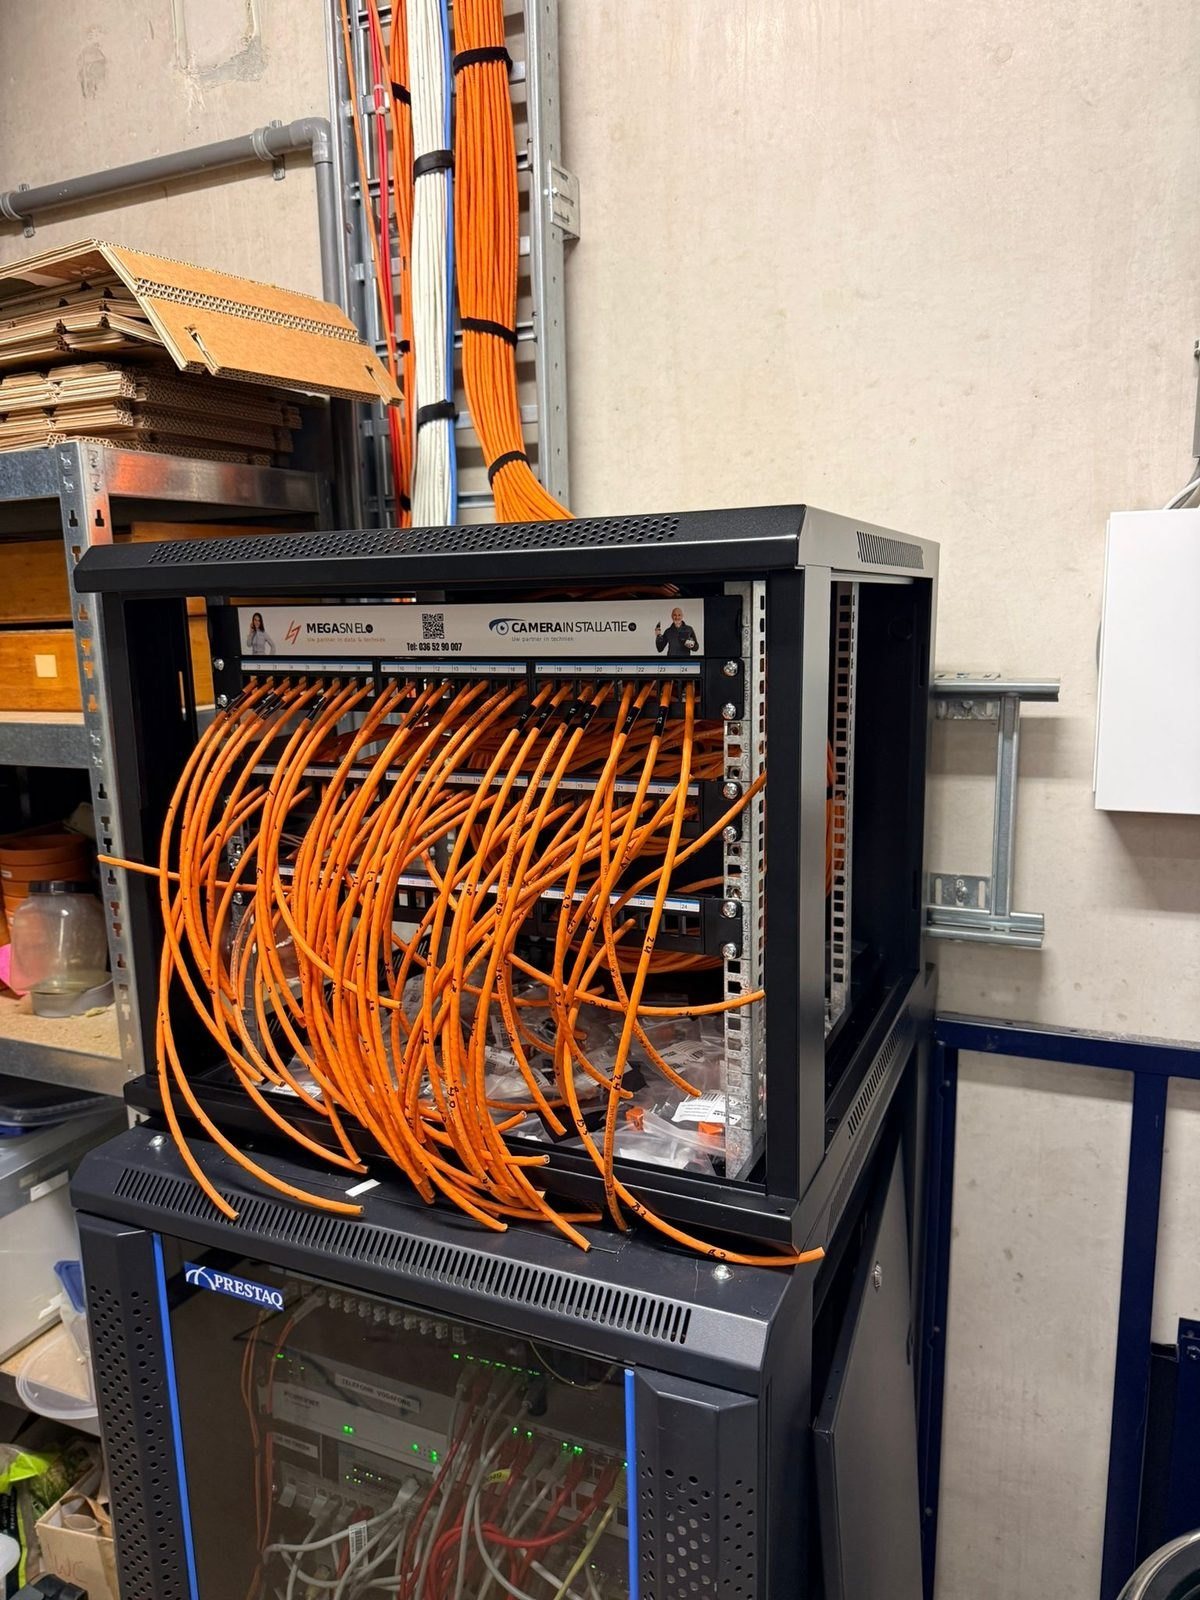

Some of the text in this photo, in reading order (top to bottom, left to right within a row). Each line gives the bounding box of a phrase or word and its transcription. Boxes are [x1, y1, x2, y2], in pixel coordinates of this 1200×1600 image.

[511, 621, 628, 633] CAMERAINSTALLATIE
[431, 642, 440, 651] 52
[440, 642, 450, 651] 90
[450, 642, 463, 651] 007
[213, 1273, 285, 1310] PRESTAQ
